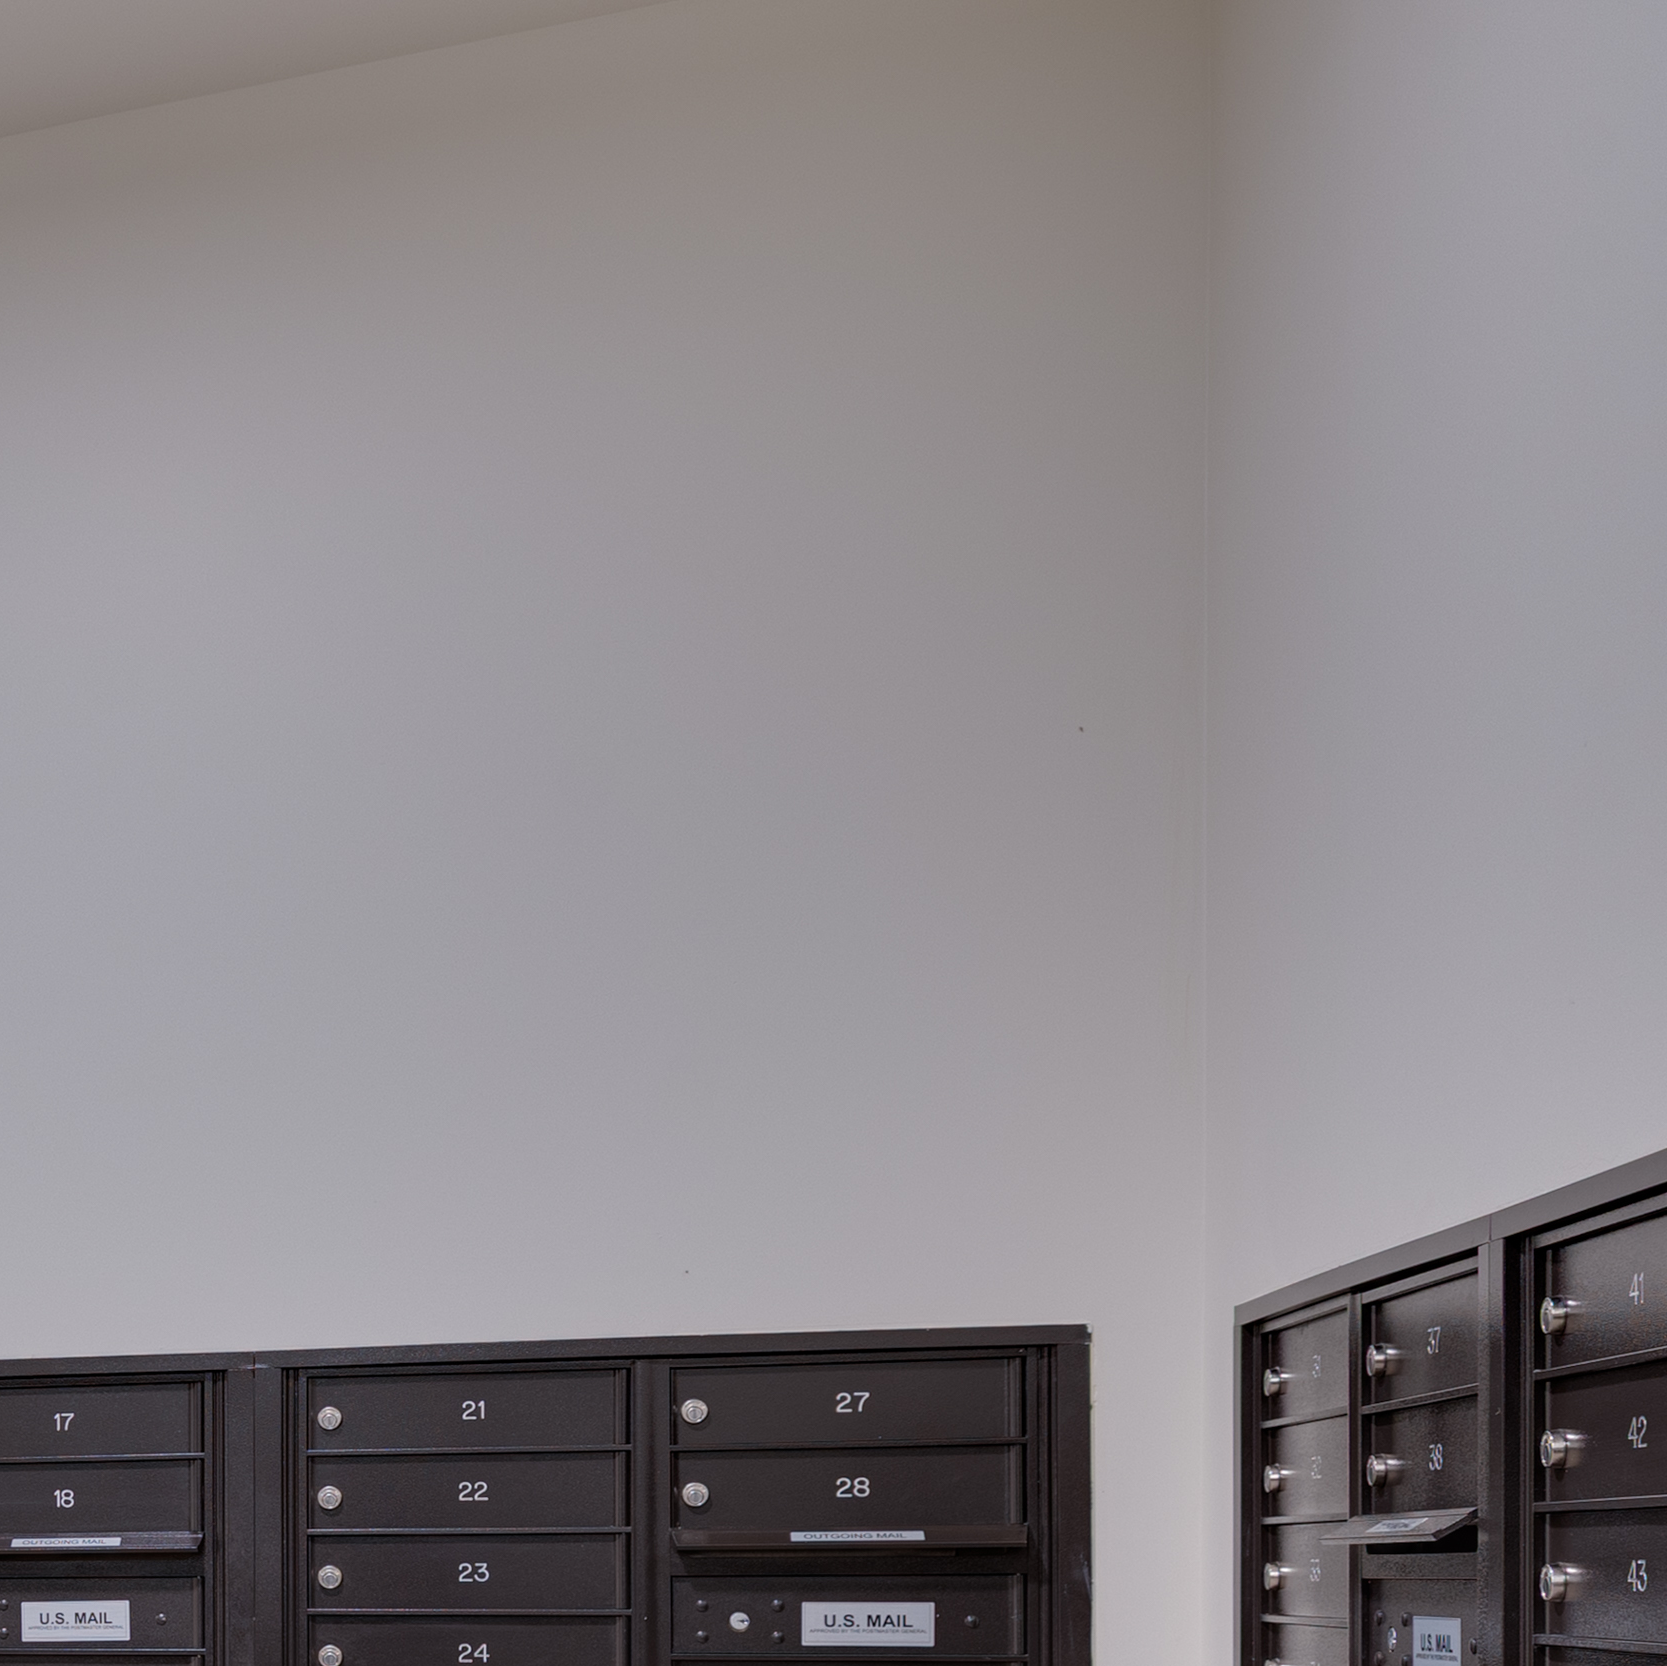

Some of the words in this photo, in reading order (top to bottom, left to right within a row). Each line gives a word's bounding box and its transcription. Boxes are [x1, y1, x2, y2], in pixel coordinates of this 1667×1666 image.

[1628, 1272, 1644, 1305] 41
[1426, 1326, 1441, 1355] 37
[1311, 1354, 1321, 1378] 31
[461, 1400, 485, 1420] 21
[835, 1391, 870, 1413] 27
[53, 1412, 75, 1432] 17
[1627, 1415, 1648, 1449] 42
[1310, 1455, 1322, 1480] 32
[1428, 1443, 1443, 1471] 38
[458, 1481, 489, 1502] 22
[835, 1476, 871, 1498] 28
[53, 1489, 75, 1509] 18
[803, 1532, 874, 1540] OUTGOING
[458, 1562, 490, 1583] 23
[1309, 1558, 1321, 1582] 33
[1627, 1559, 1648, 1592] 43
[39, 1612, 69, 1625] U.S.
[74, 1611, 113, 1624] MAIL
[823, 1614, 860, 1628] U.S.
[866, 1614, 914, 1628] MAIL
[458, 1643, 491, 1664] 24
[1420, 1633, 1434, 1652] U.S.
[1435, 1634, 1454, 1653] MAIL
